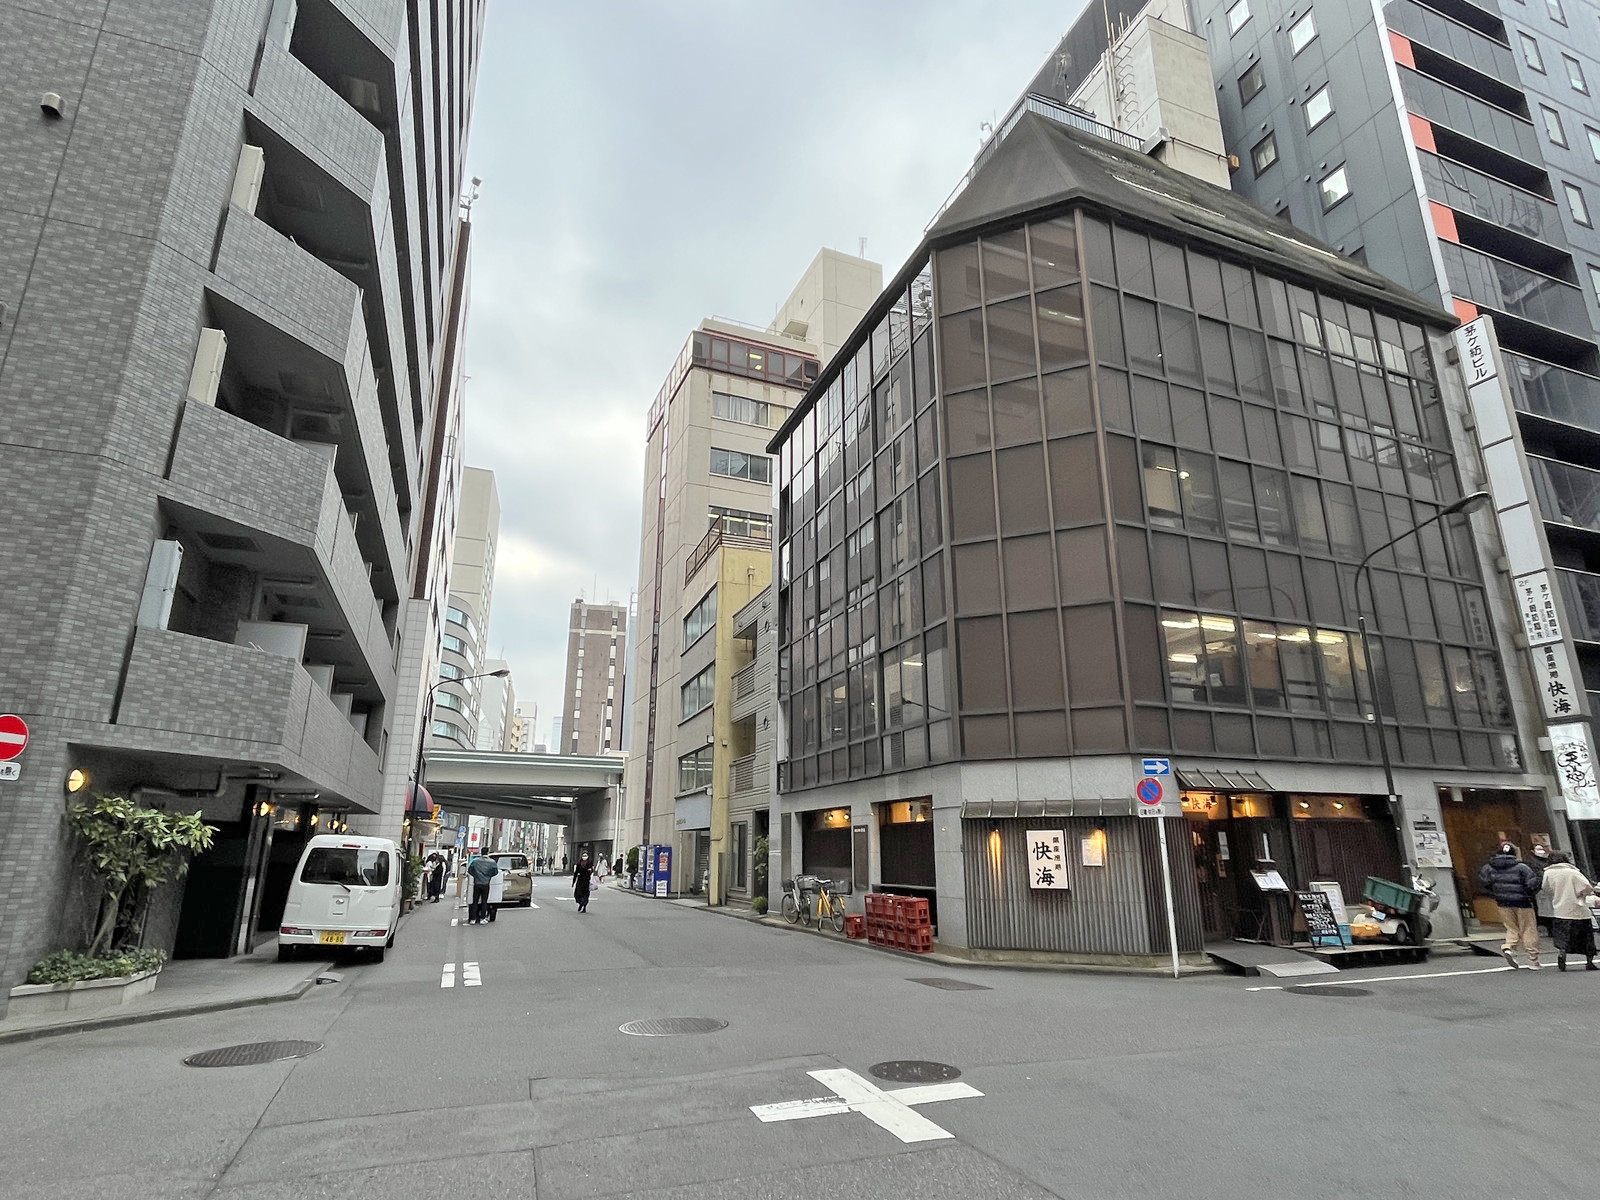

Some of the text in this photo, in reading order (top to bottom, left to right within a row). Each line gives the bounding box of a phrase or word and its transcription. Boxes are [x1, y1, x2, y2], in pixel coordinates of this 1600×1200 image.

[1518, 579, 1529, 588] 2F
[1548, 681, 1572, 714] 快海
[1032, 841, 1055, 886] 快海
